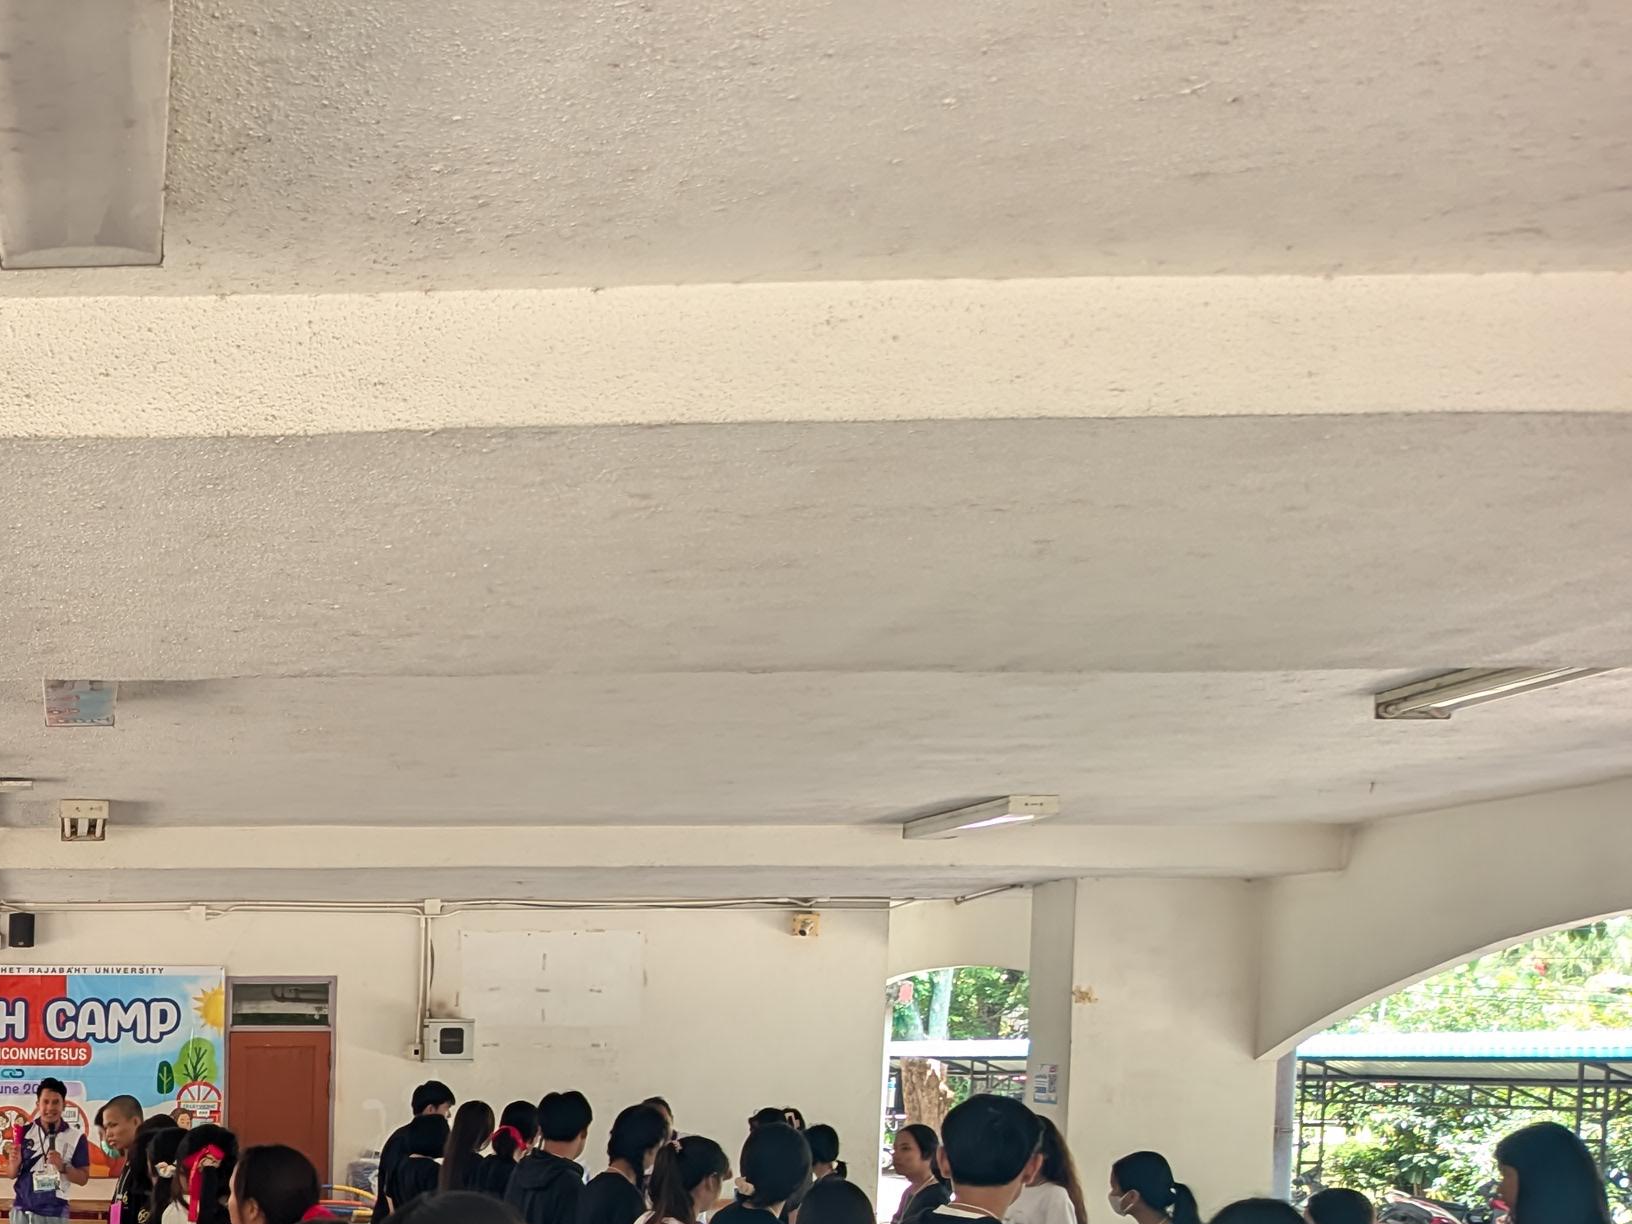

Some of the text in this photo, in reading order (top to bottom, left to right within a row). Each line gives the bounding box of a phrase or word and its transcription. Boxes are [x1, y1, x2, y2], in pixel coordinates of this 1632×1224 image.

[95, 967, 165, 975] UNIVERSITY
[45, 998, 179, 1042] CAMP
[23, 1083, 38, 1094] 20
